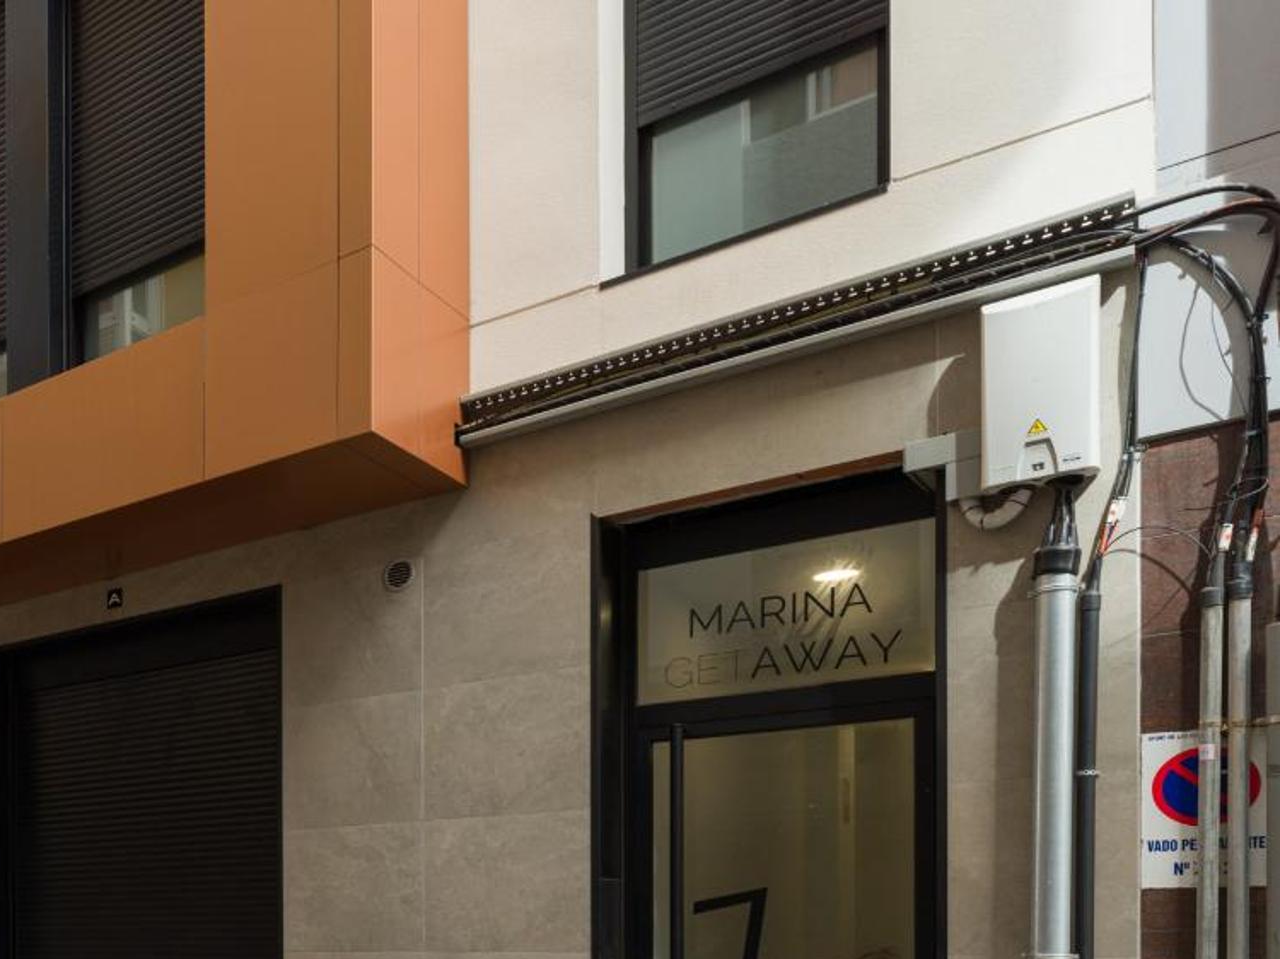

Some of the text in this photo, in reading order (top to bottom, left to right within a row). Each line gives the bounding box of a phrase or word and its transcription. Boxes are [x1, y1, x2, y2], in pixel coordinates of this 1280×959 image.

[688, 583, 873, 638] MARINA
[664, 629, 903, 689] GETAWAY
[1147, 839, 1178, 852] VADO
